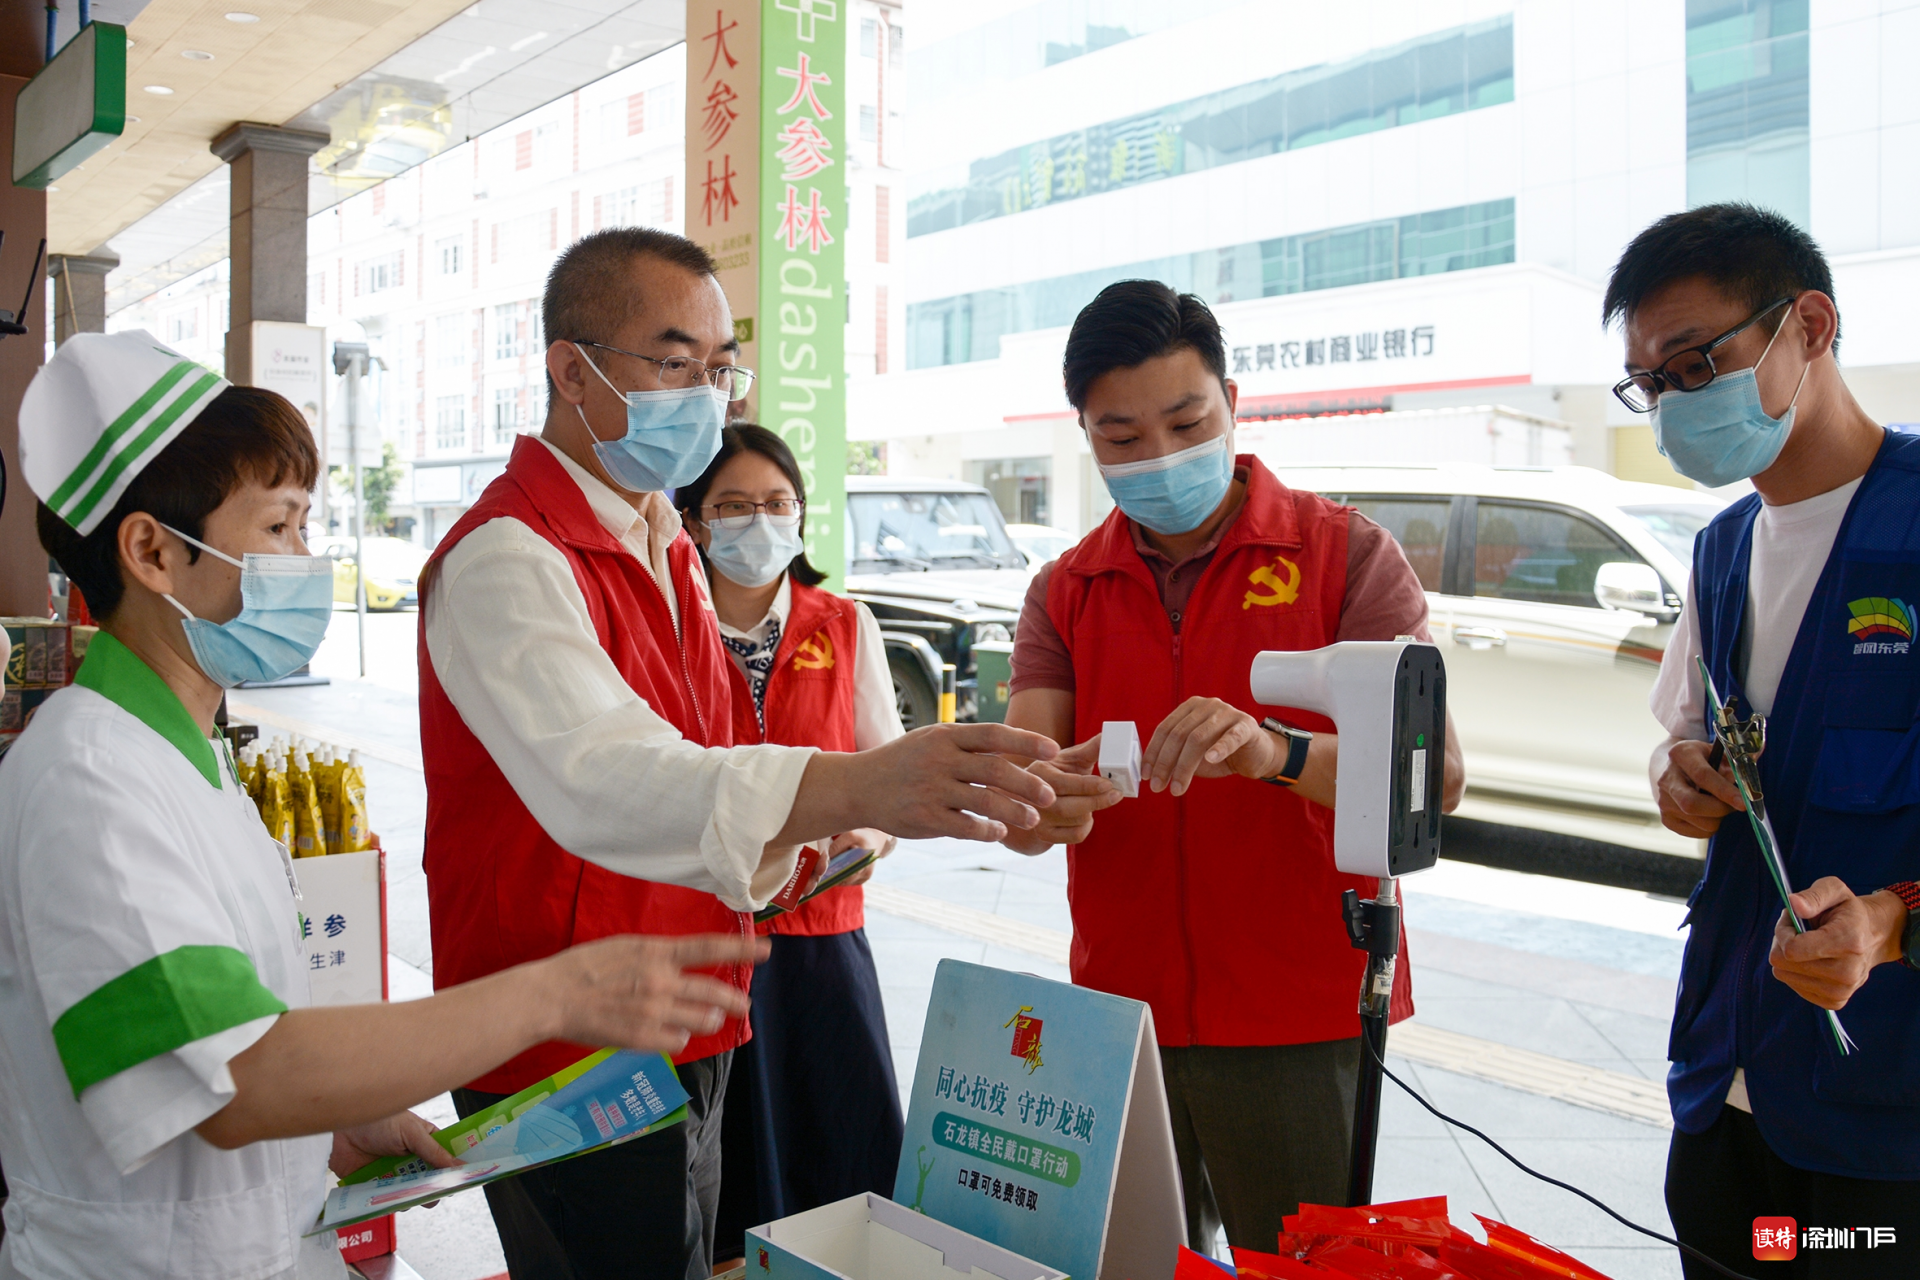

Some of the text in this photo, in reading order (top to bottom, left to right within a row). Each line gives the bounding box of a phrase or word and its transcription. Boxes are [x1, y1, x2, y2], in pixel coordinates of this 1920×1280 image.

[701, 9, 740, 227] 大参林
[774, 51, 834, 255] 大参林
[1231, 325, 1435, 374] 东莞农村商业银行
[309, 949, 346, 970] 生津
[934, 1065, 1096, 1145] 同心抗疫 守护龙城
[943, 1120, 1070, 1180] 石龙镇全民戴口罩行动
[957, 1168, 1040, 1212] 口罩可免费领取
